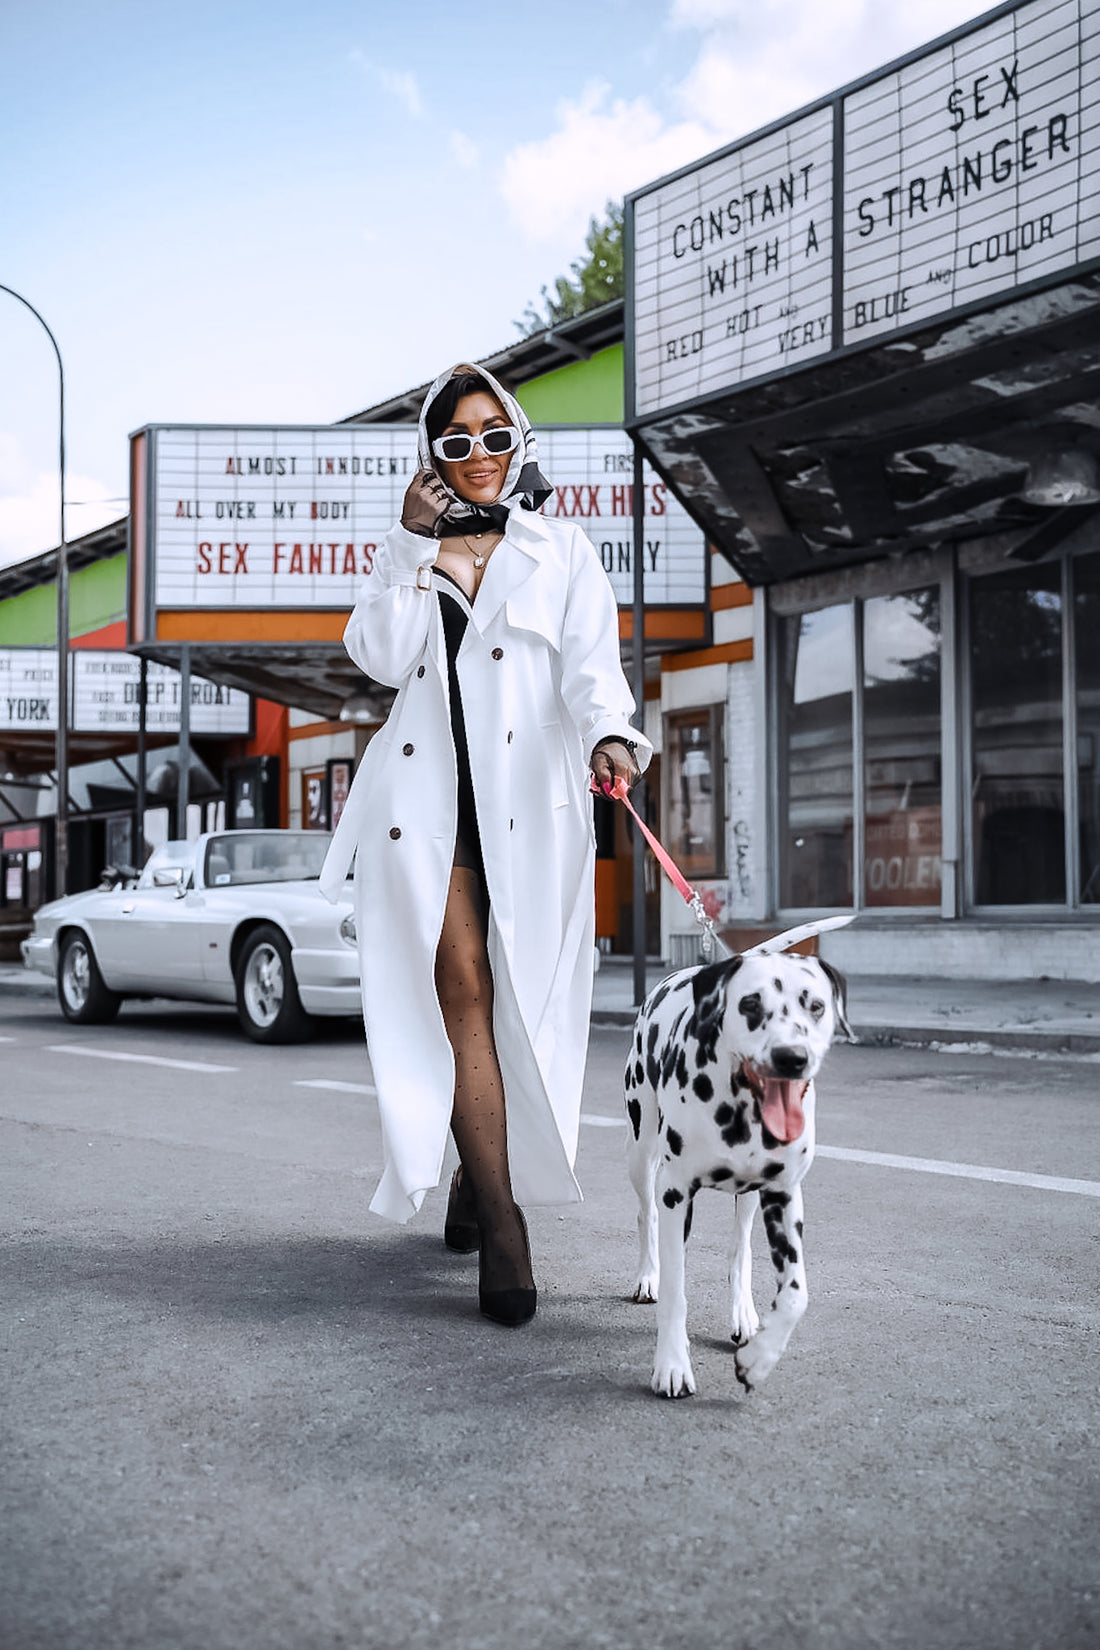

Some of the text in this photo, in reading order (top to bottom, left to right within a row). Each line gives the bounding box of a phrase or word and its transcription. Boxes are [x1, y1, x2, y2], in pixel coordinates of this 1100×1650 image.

[672, 59, 1020, 259] CONSTANT SEX
[706, 112, 1070, 298] WITH A STRANGER
[967, 212, 1054, 270] COLOR
[665, 330, 704, 363] RED
[725, 304, 765, 340] HOT
[778, 286, 914, 354] VERY BLUE
[225, 457, 408, 476] ALMOST INNOCENT
[176, 500, 350, 520] ALL OVER MY BODY
[197, 542, 377, 575] SEX FANTAS
[601, 541, 660, 573] ONY
[7, 698, 50, 720] YORK
[172, 683, 231, 705] TROAT
